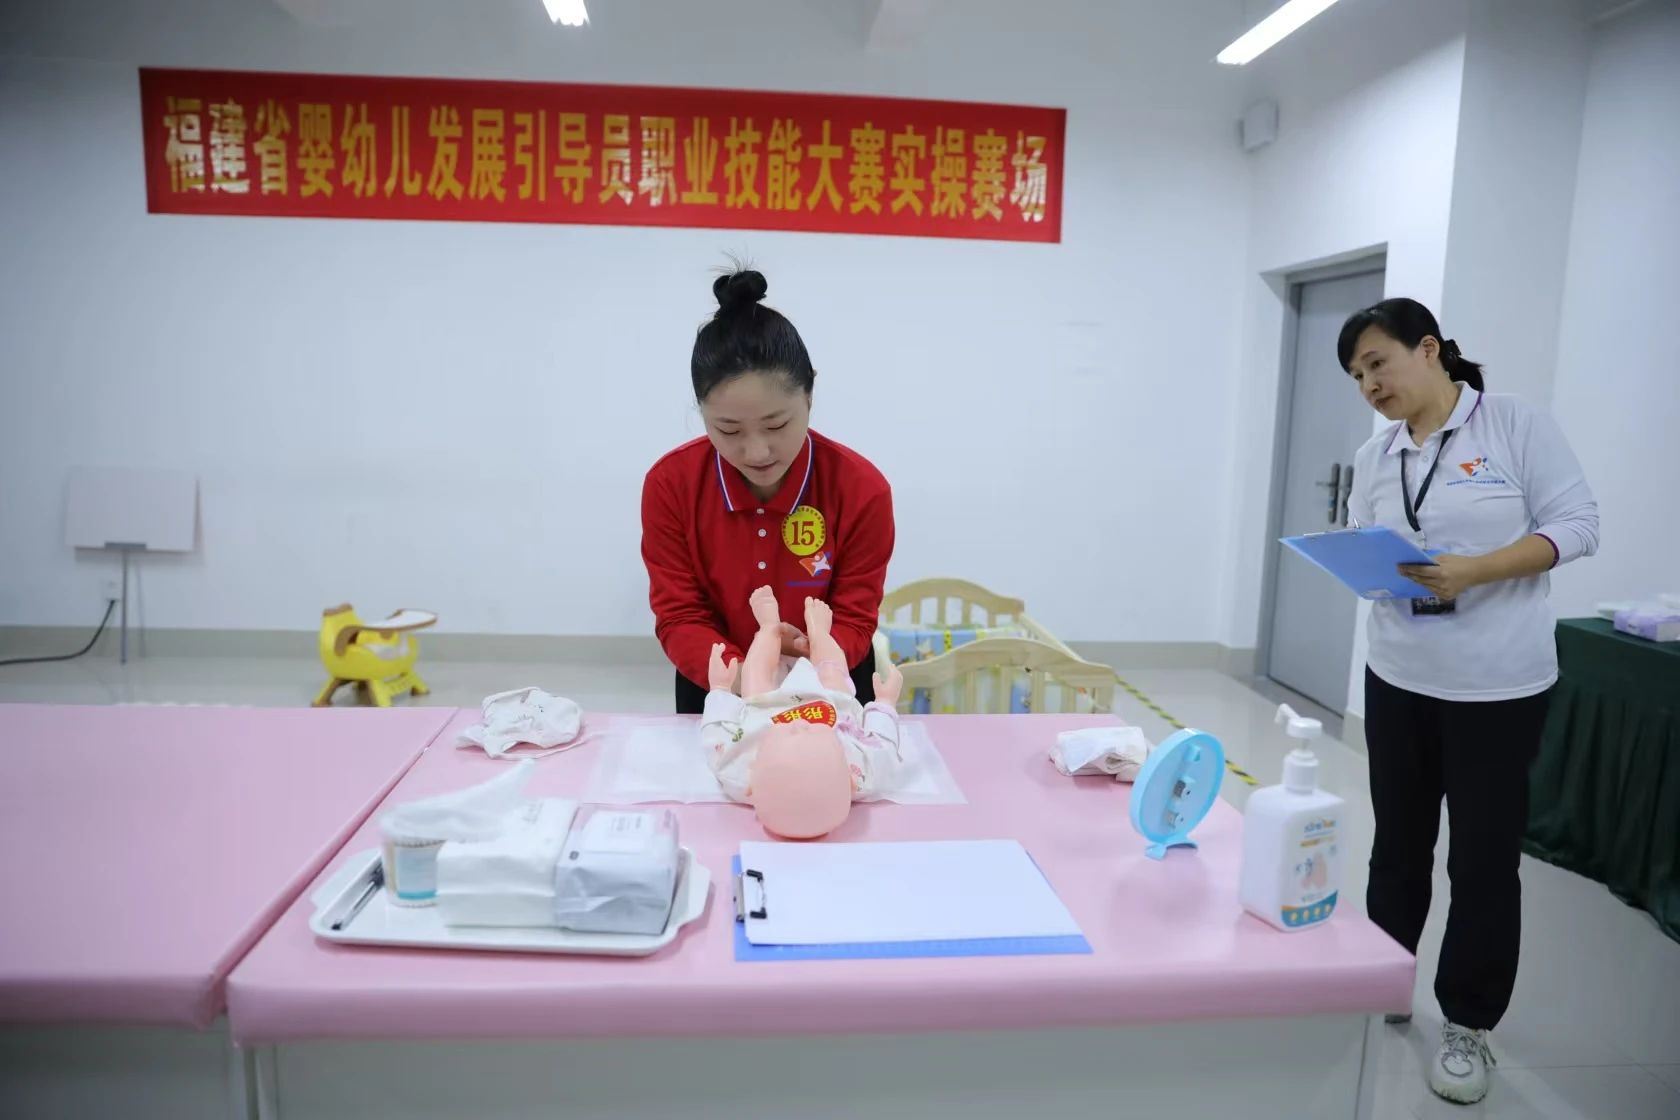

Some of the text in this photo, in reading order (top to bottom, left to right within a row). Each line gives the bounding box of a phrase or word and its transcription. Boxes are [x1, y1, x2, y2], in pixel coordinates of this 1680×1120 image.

[163, 96, 1048, 223] 福建省婴幼儿发展引导员职业技能大赛实操赛场
[791, 521, 815, 546] 15
